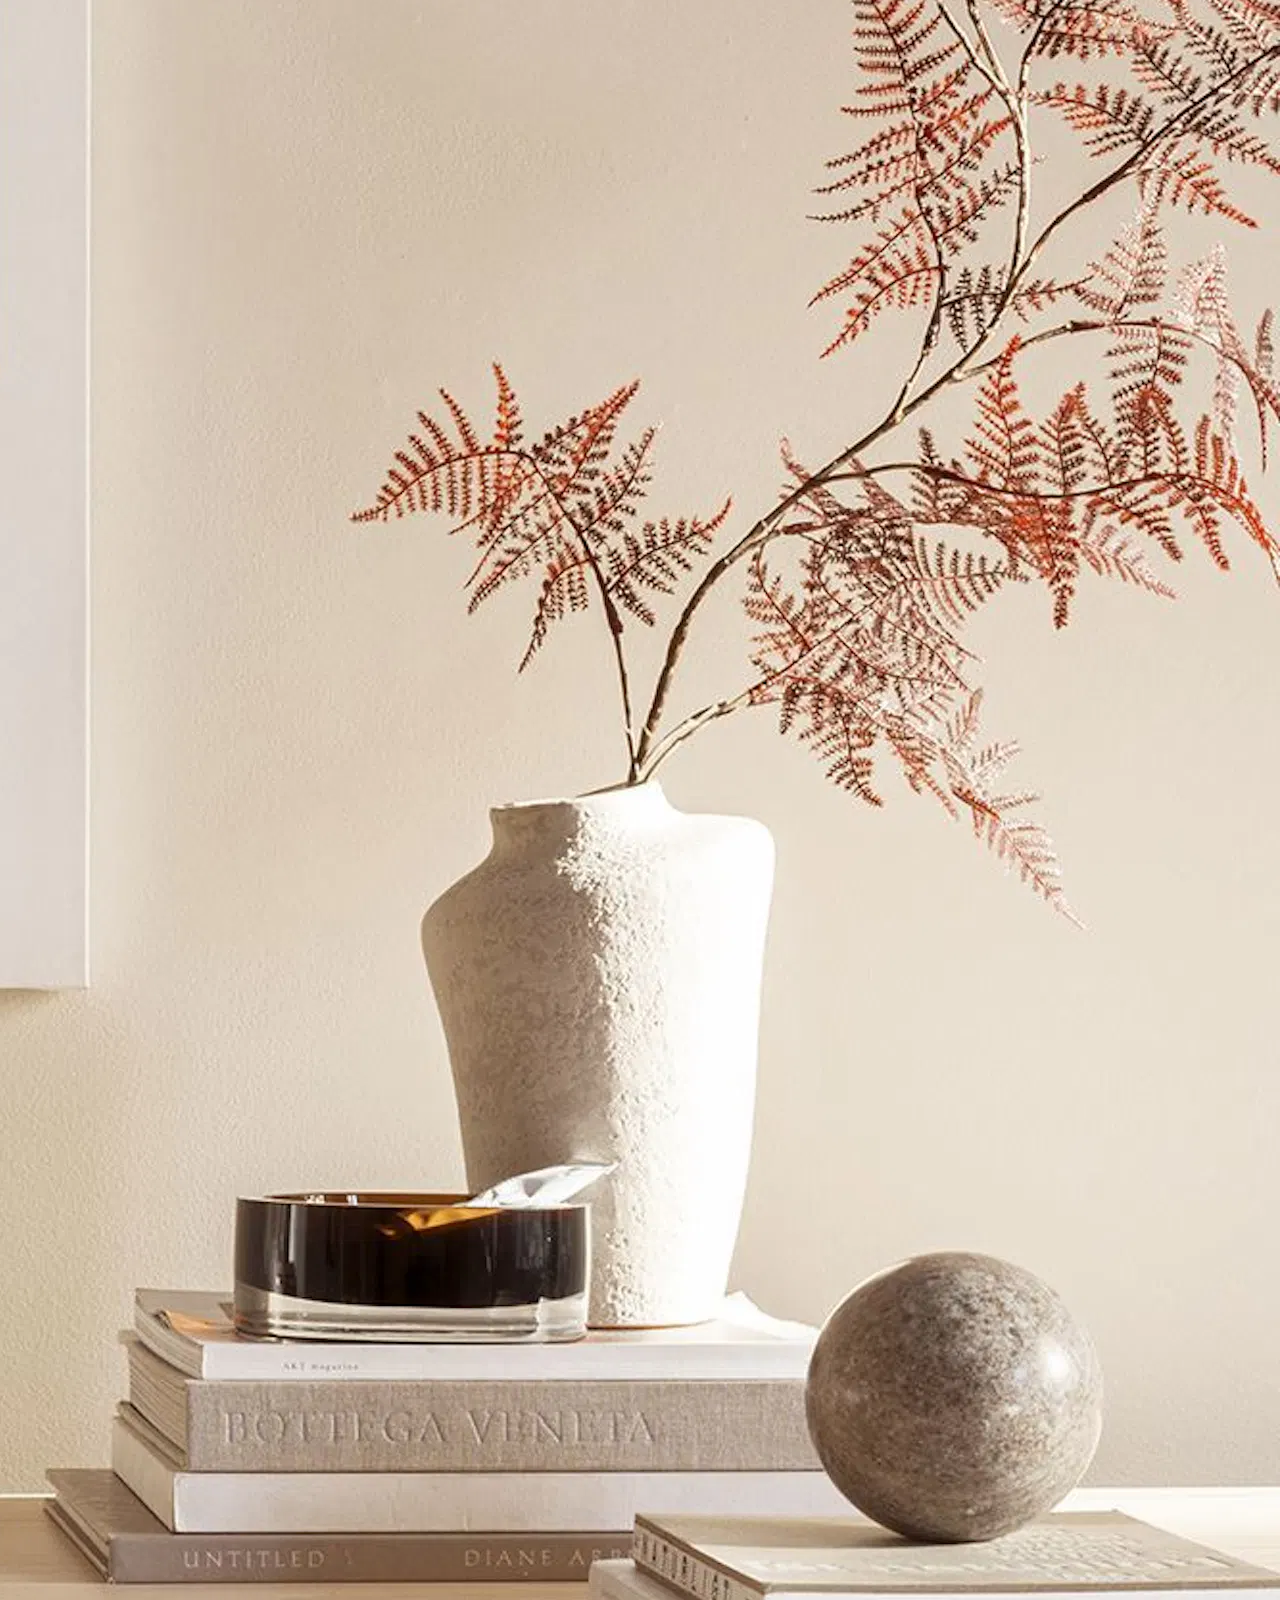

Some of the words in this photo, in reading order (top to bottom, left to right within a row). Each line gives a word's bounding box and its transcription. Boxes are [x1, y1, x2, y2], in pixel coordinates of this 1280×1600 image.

[224, 1410, 446, 1445] BOTTEGA
[465, 1410, 656, 1445] VENETA
[183, 1549, 326, 1569] UNTITLED
[464, 1549, 553, 1568] DIANE
